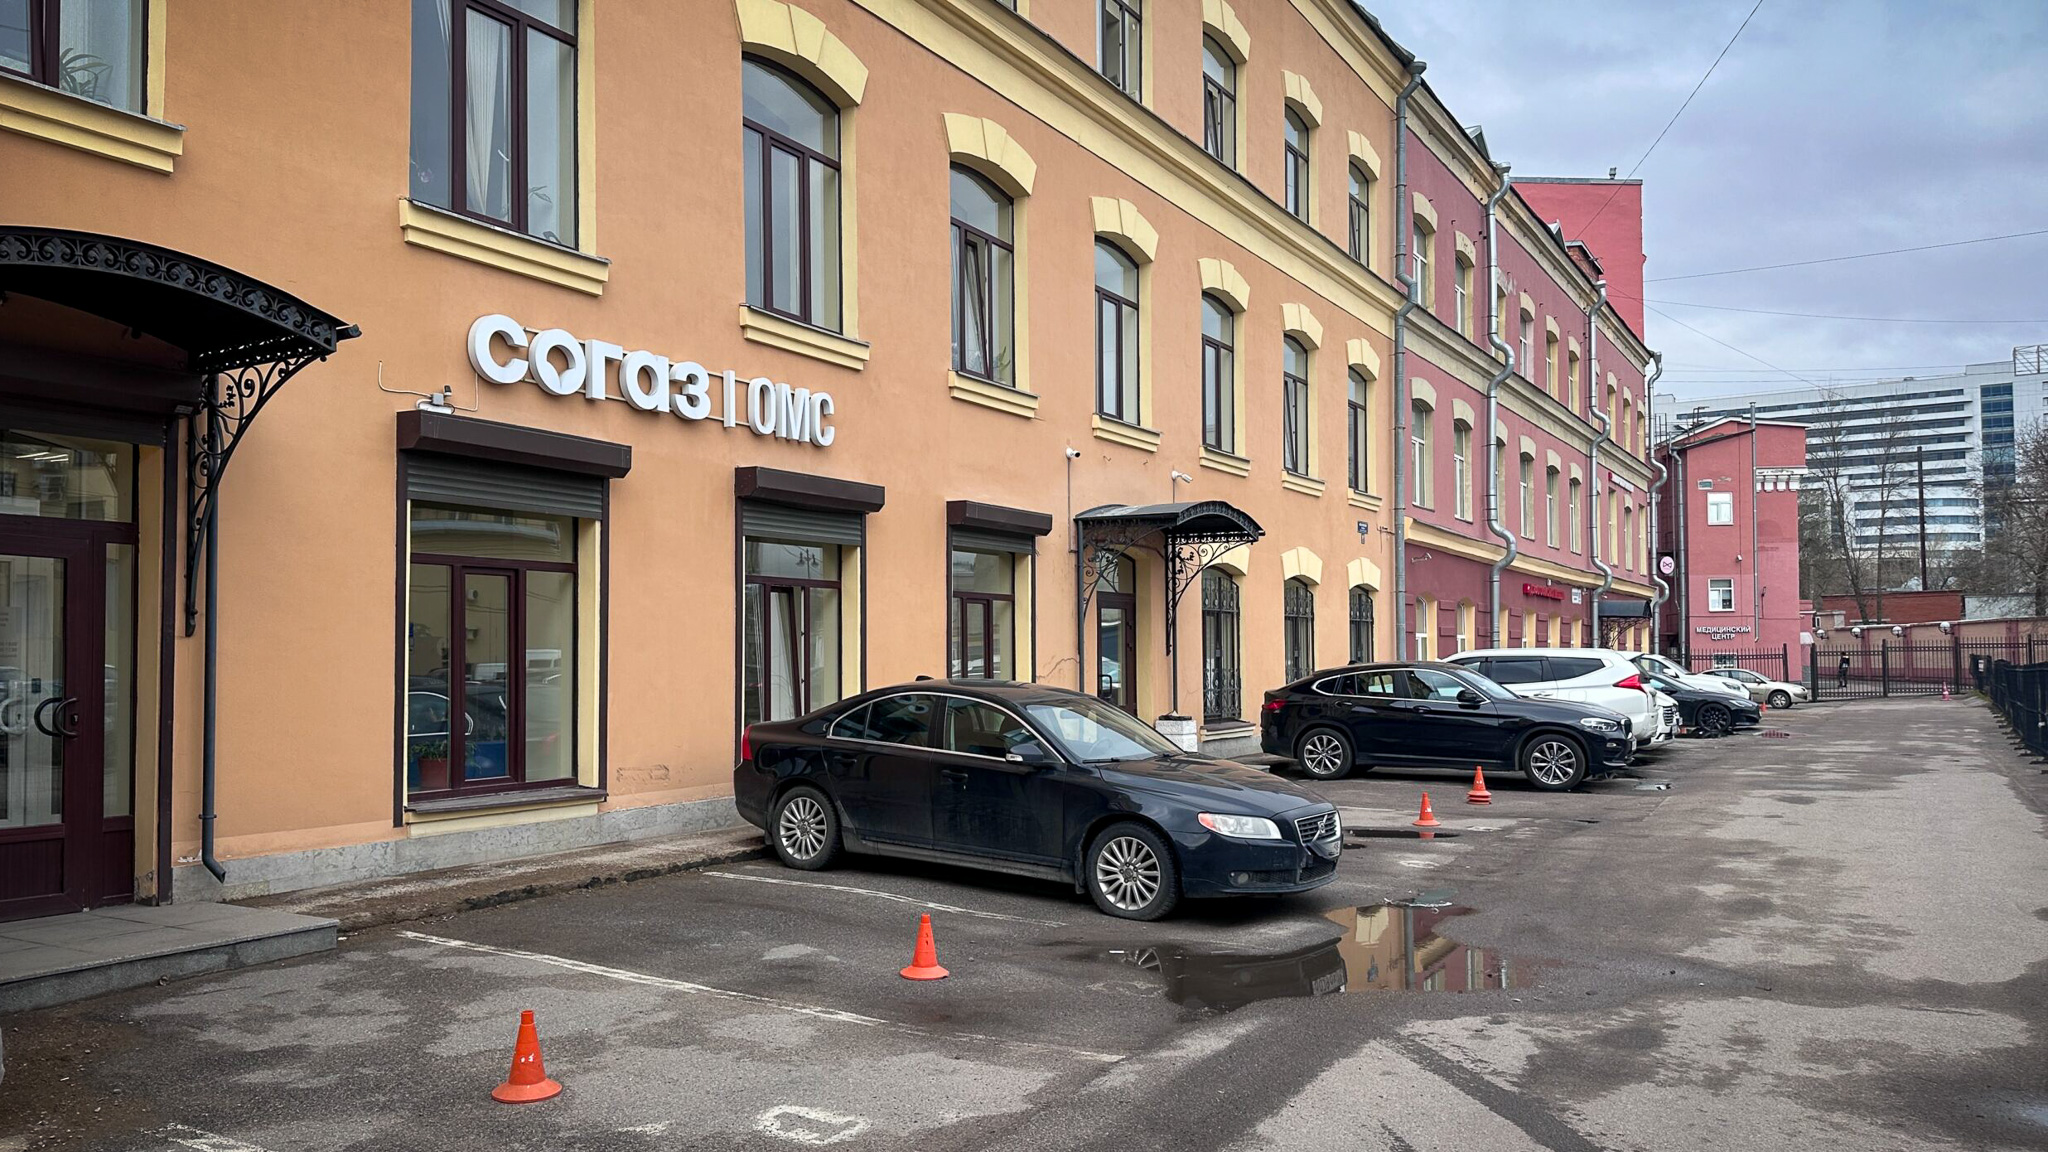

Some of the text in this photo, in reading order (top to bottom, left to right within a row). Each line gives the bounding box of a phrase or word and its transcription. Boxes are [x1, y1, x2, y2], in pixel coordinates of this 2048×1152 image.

[747, 377, 835, 447] ОМС
[1695, 625, 1751, 634] МЕДИЦИНСКИЙ
[1711, 633, 1736, 641] ЦЕНТР
